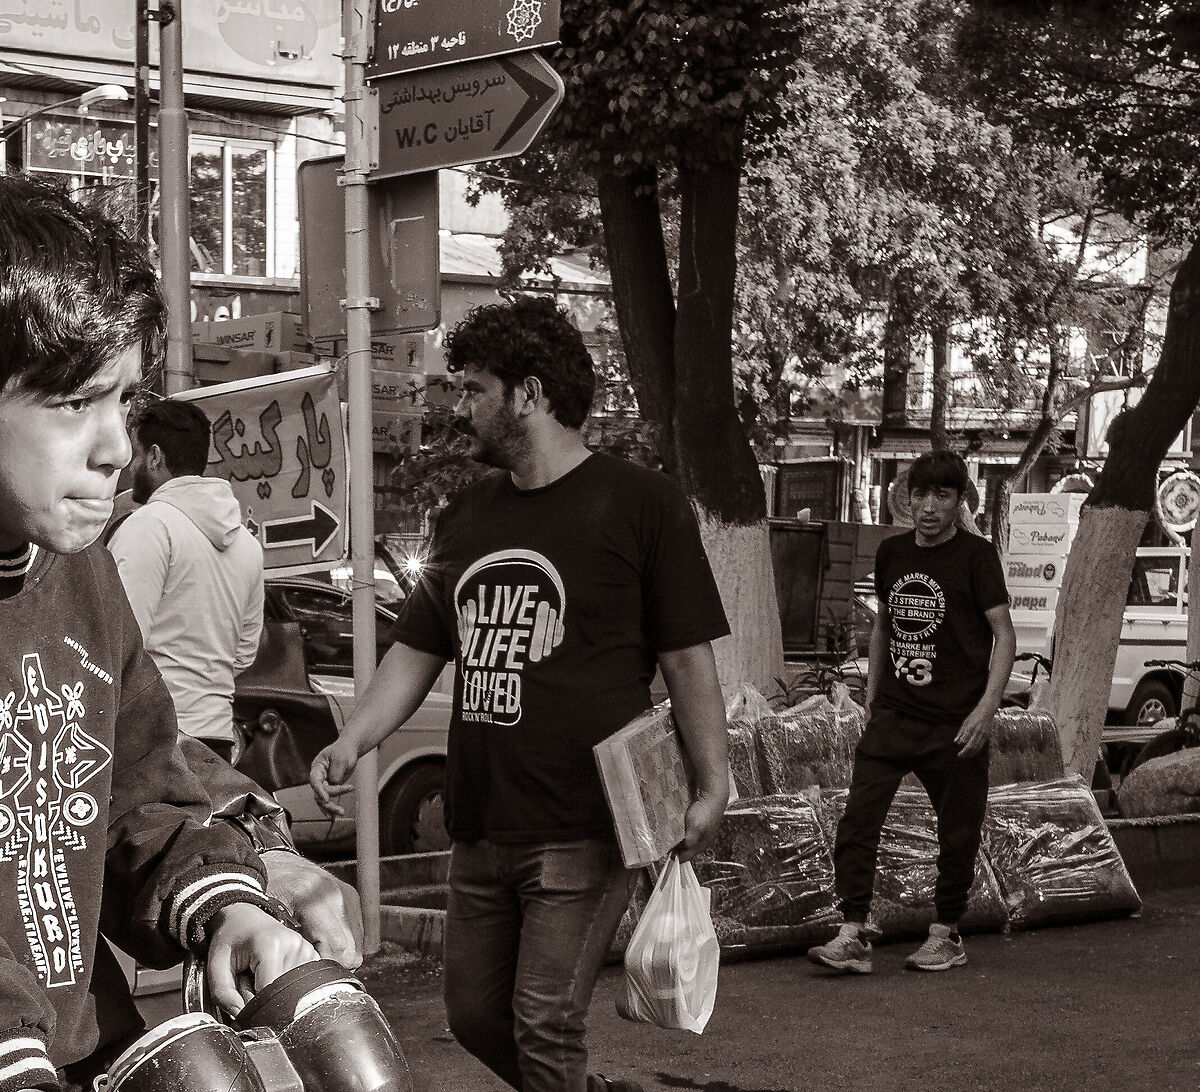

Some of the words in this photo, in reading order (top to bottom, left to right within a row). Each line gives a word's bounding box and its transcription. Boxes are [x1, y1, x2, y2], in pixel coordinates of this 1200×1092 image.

[401, 40, 429, 56] منطقه
[430, 35, 440, 52] ۳
[441, 30, 467, 52] ناحیه
[380, 85, 442, 114] بهداشتی
[442, 74, 507, 104] سرویس
[395, 122, 438, 149] W.C
[444, 108, 495, 143] آقایان
[371, 345, 394, 356] SAR
[372, 384, 397, 394] SAR
[904, 572, 930, 583] MARKE
[477, 584, 539, 625] LIVE
[907, 609, 935, 619] BRAND
[467, 628, 530, 670] LIFE
[896, 641, 921, 650] MARKE
[922, 644, 936, 652] MIT
[462, 670, 521, 714] LOVED
